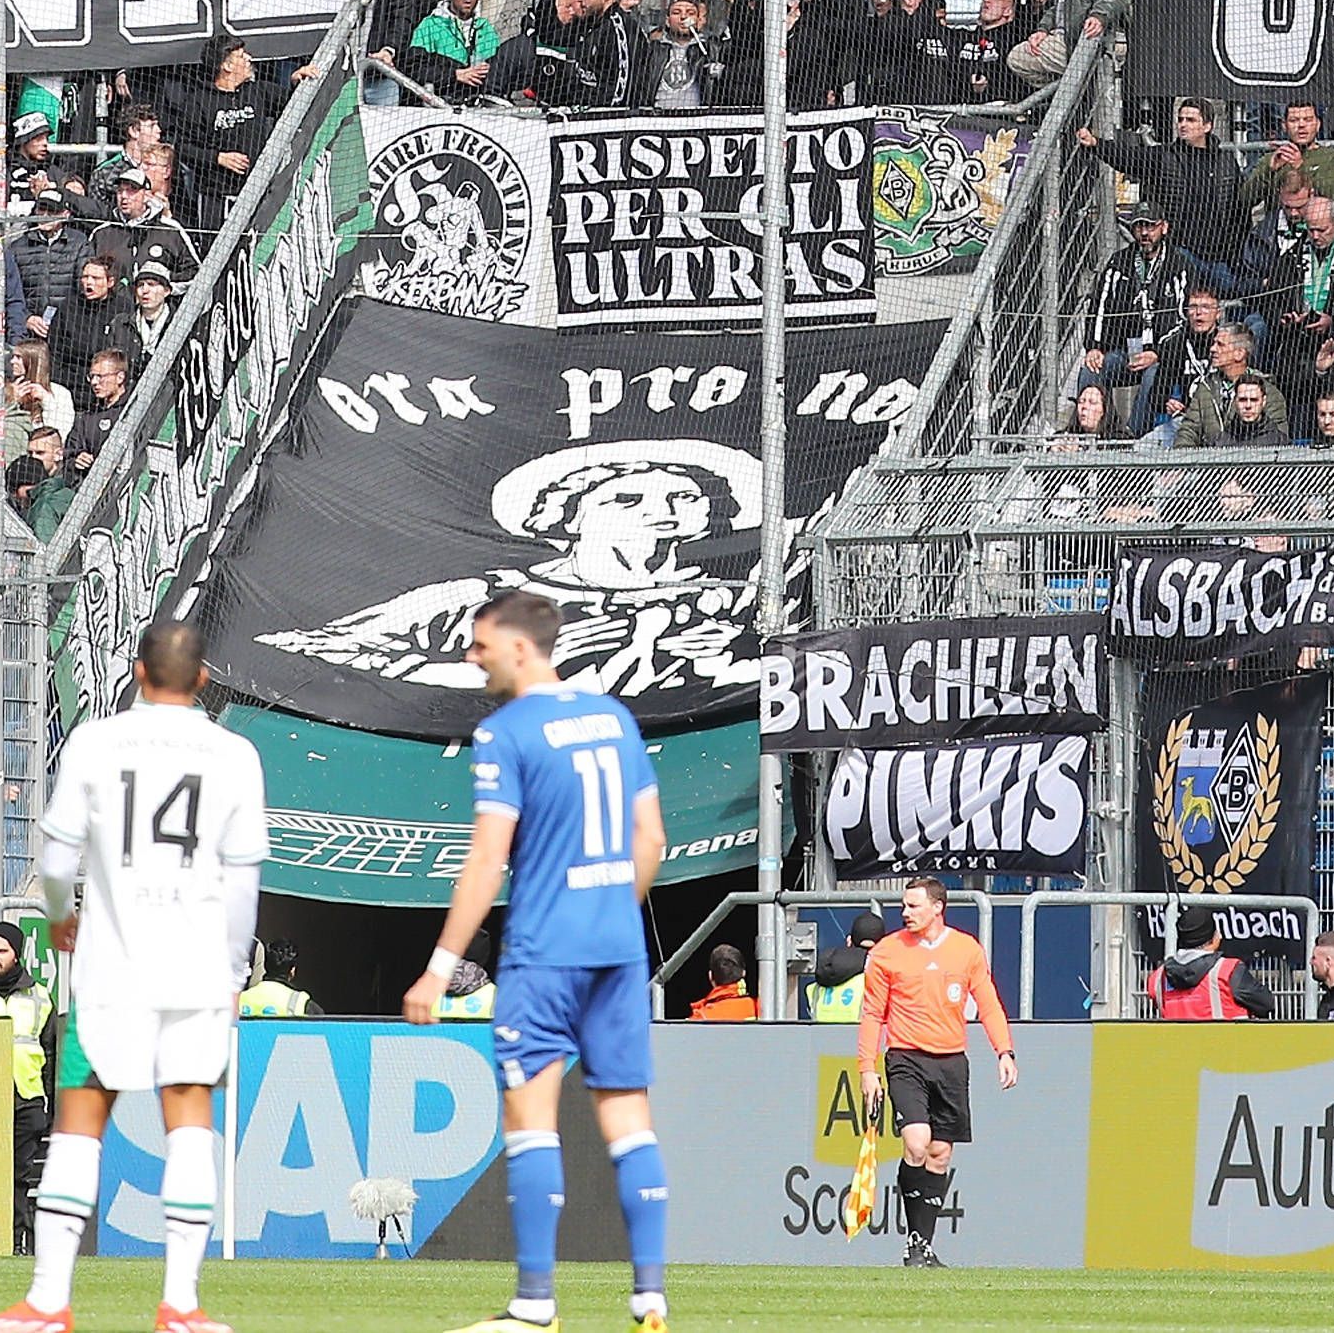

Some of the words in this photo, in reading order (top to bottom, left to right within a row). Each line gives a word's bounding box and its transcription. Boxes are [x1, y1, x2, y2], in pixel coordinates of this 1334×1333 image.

[561, 187, 712, 244] PER
[318, 366, 496, 434] ora
[557, 365, 750, 440] pro
[759, 633, 1099, 736] BRACHELEN
[120, 769, 201, 868] 14
[571, 747, 624, 860] 11
[825, 736, 1088, 862] PINKIS
